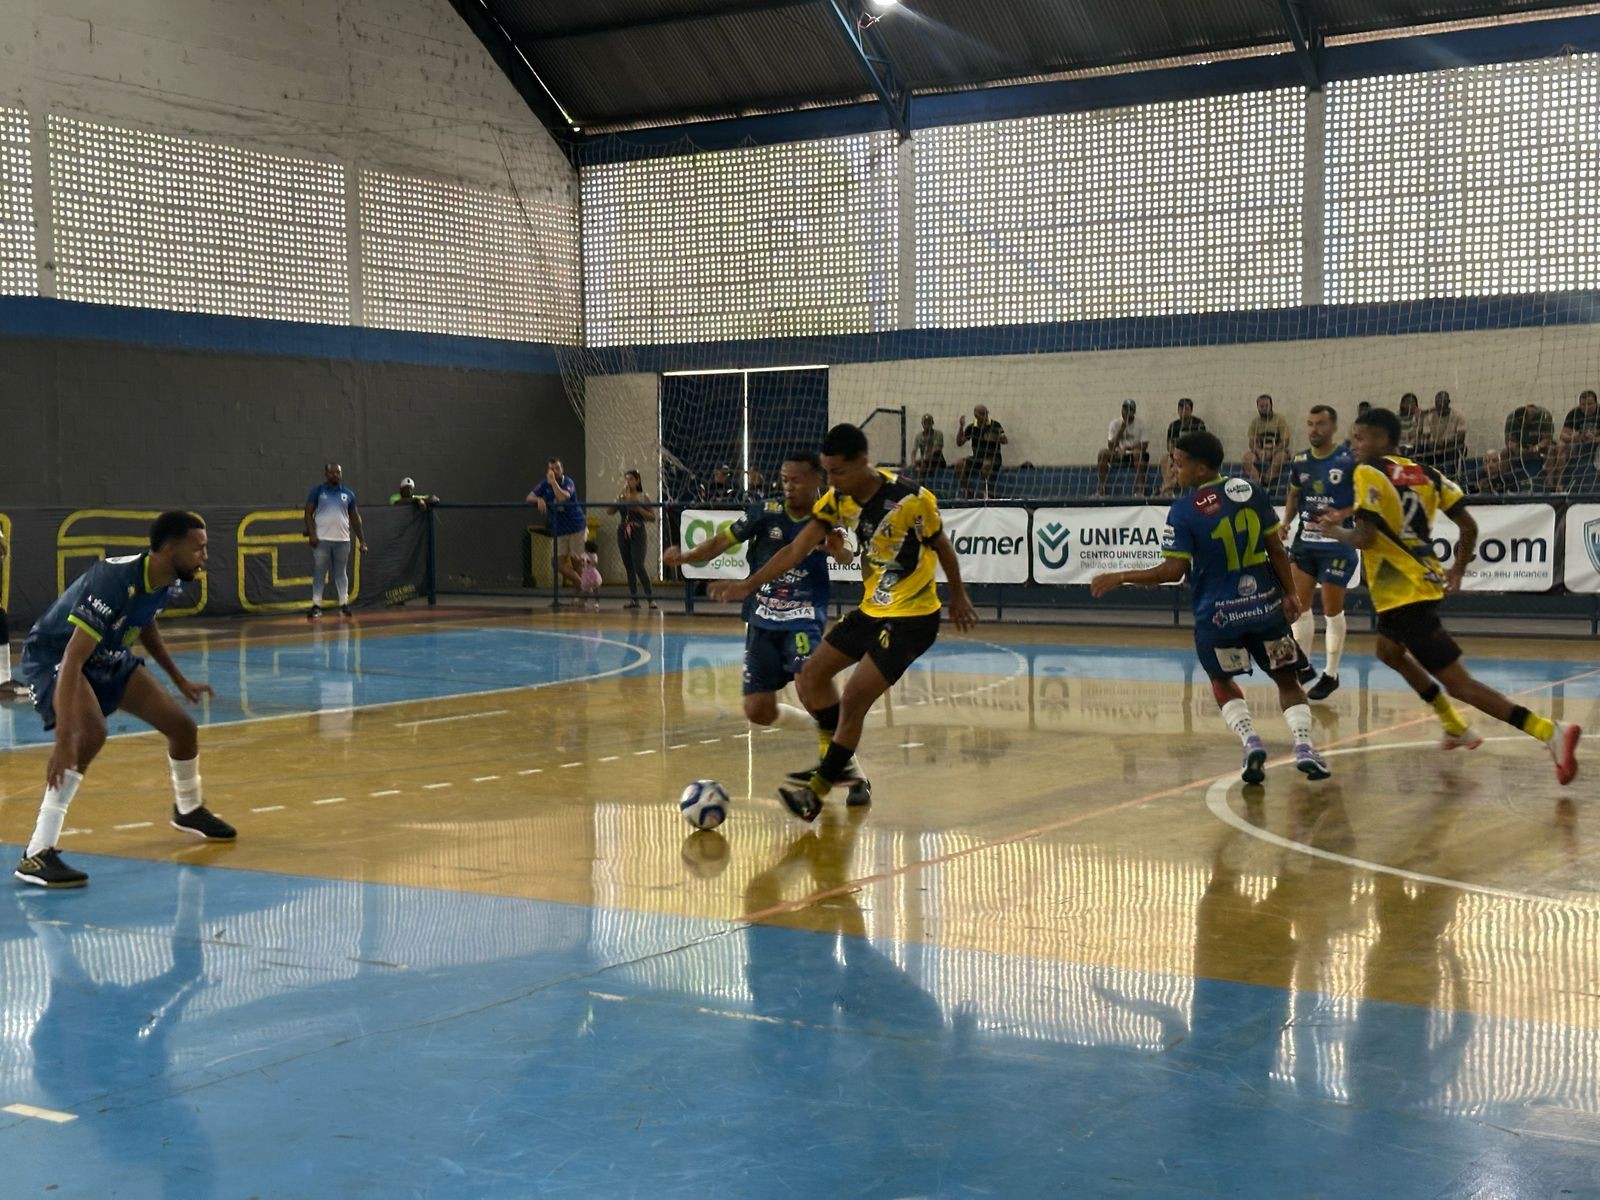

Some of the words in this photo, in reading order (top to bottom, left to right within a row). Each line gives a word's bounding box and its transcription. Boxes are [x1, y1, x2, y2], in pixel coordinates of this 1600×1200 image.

[1080, 527, 1160, 546] UNIFAA
[1211, 507, 1267, 571] 12
[1080, 550, 1115, 559] CENTRO
[1513, 569, 1548, 578] alcance
[1228, 605, 1263, 622] Biotech
[795, 631, 810, 655] 9
